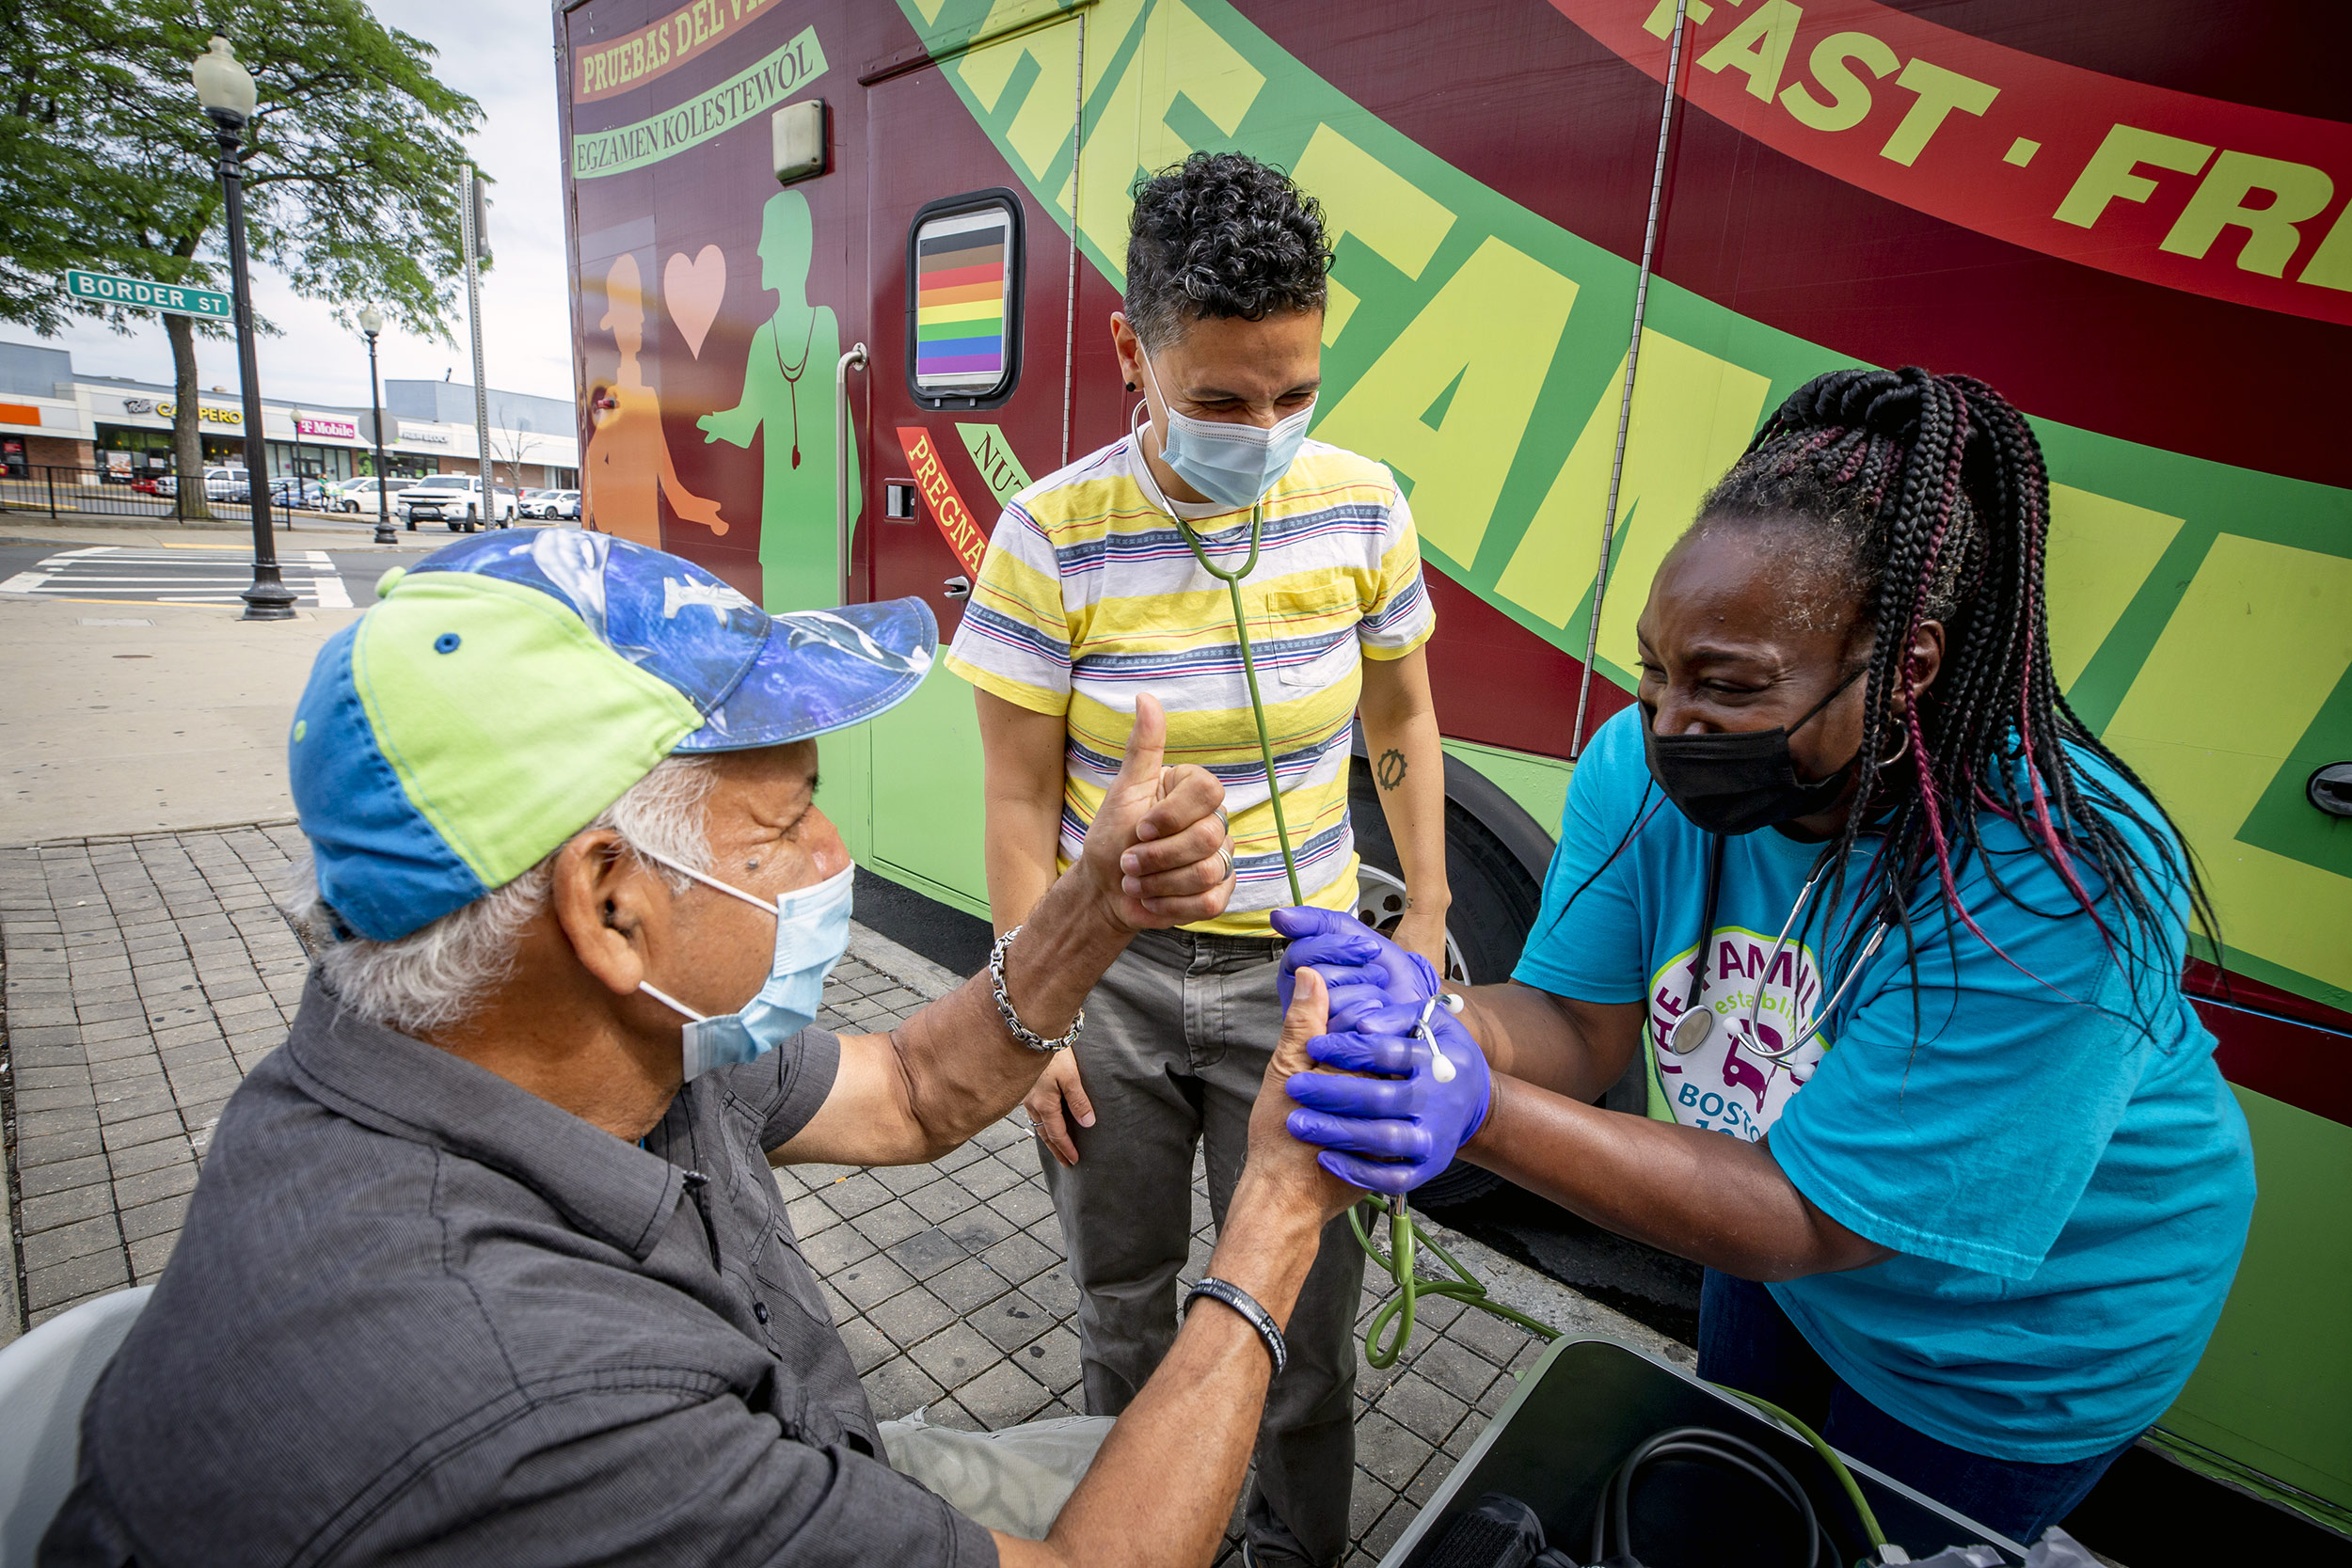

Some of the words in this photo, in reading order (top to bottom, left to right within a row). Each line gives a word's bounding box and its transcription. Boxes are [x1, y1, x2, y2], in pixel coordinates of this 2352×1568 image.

[582, 22, 670, 94] PRUEBAS
[675, 0, 724, 57] DEL
[577, 120, 659, 172] EGZAMEN
[662, 40, 814, 150] KOLESTEWÓL
[78, 275, 185, 309] BORDER
[199, 296, 222, 313] ST
[156, 403, 244, 424] CAPERO
[314, 420, 354, 437] Mobile
[908, 435, 987, 574] PREGNA
[1685, 940, 1816, 1037] AMIL
[1232, 1296, 1263, 1326] Helmet
[1261, 1323, 1271, 1335] of
